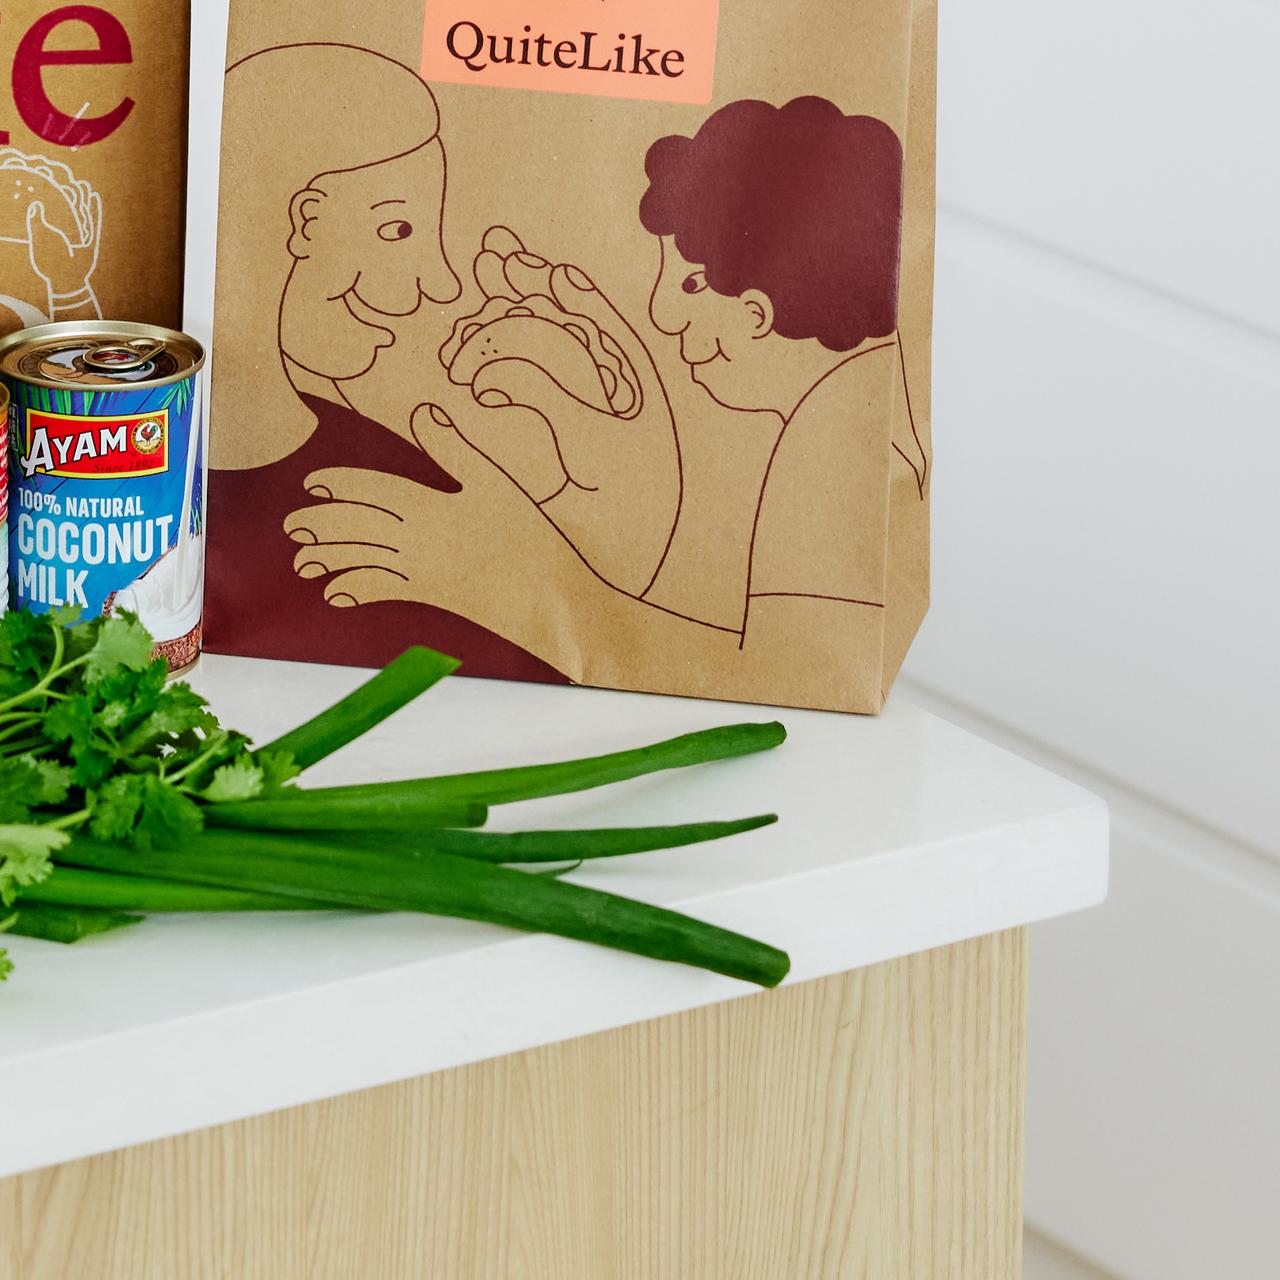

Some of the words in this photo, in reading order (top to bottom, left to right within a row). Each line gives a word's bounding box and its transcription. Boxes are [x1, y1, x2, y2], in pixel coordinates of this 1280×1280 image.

[446, 21, 685, 78] QuiteLike
[20, 426, 127, 478] AYAM
[19, 488, 61, 516] 100%
[66, 496, 144, 518] NATURAL
[18, 513, 173, 565] COCONUT
[18, 558, 89, 608] MILK
